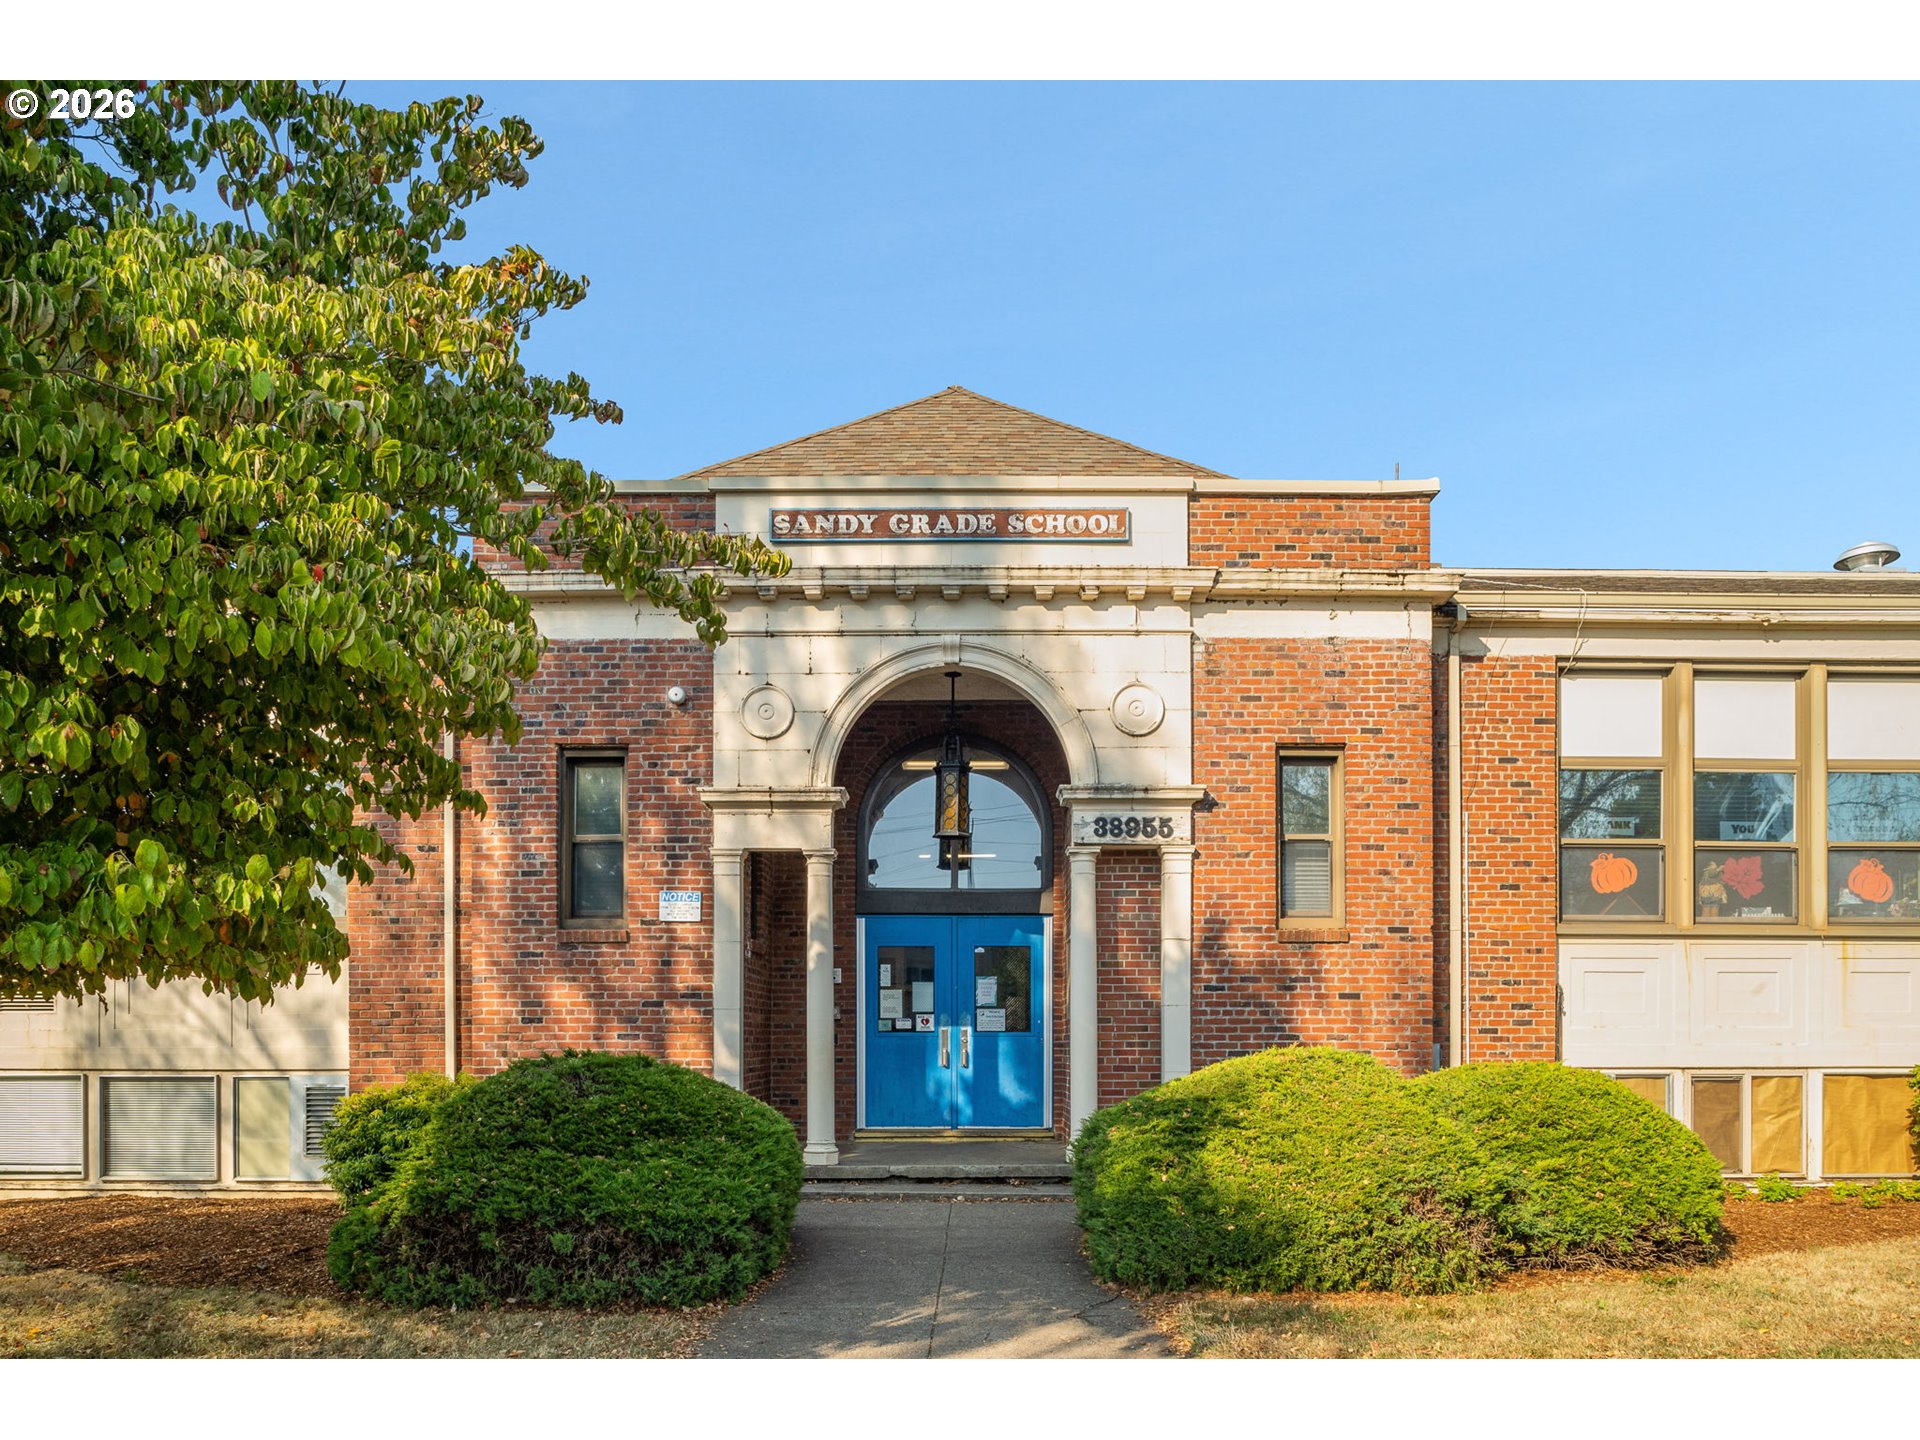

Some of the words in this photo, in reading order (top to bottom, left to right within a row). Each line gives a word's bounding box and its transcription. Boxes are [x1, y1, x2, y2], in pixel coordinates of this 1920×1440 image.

[773, 513, 879, 535] SANDY
[889, 513, 997, 535] GRADE
[1007, 513, 1125, 535] SCHOOL
[1093, 816, 1175, 839] 38955
[1730, 824, 1755, 834] YOU
[662, 892, 699, 902] NOTICE
